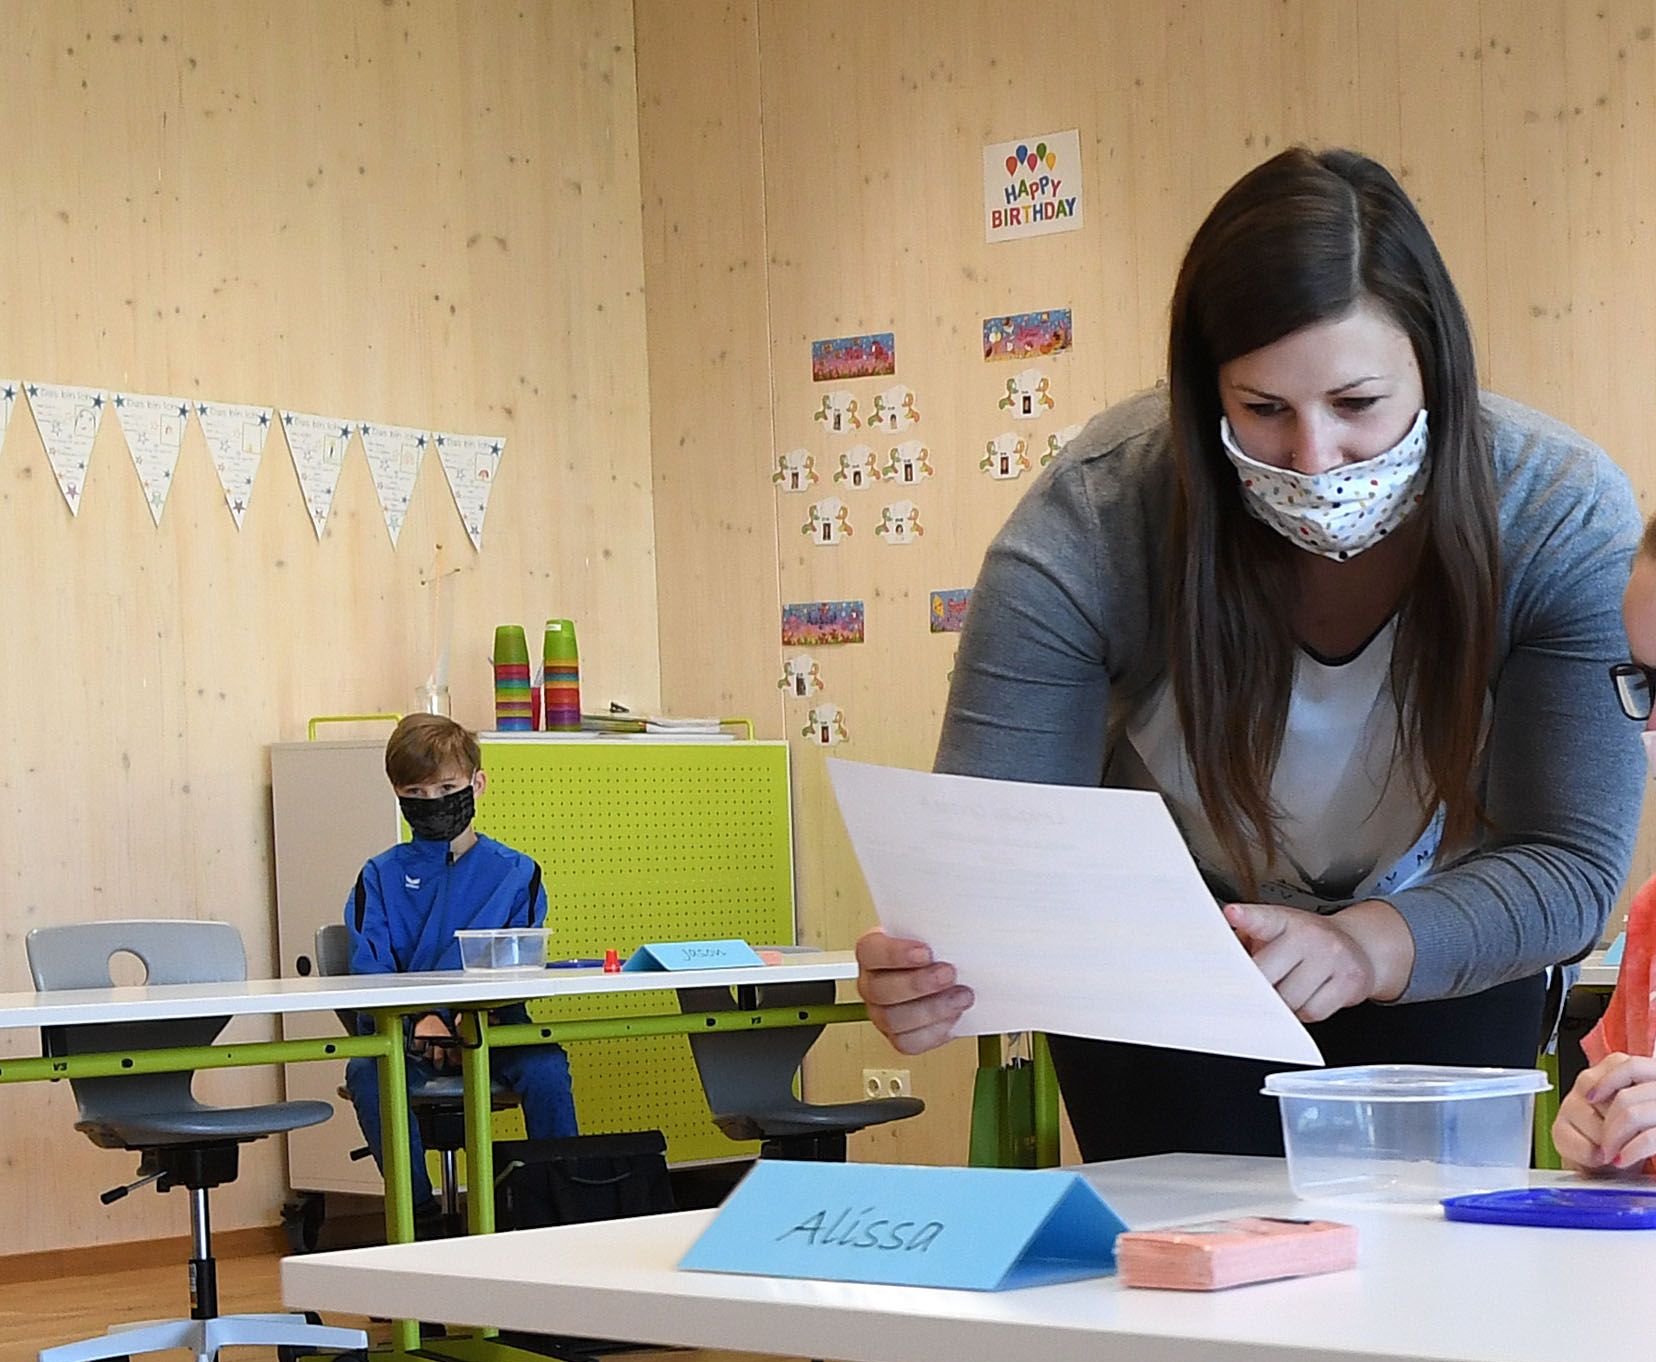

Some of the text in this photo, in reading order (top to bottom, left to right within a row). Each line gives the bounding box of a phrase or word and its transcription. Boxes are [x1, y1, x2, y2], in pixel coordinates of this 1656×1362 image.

[1004, 175, 1062, 204] HAPPY
[991, 197, 1076, 229] BIRTHDAY
[775, 1205, 945, 1253] Alissa
